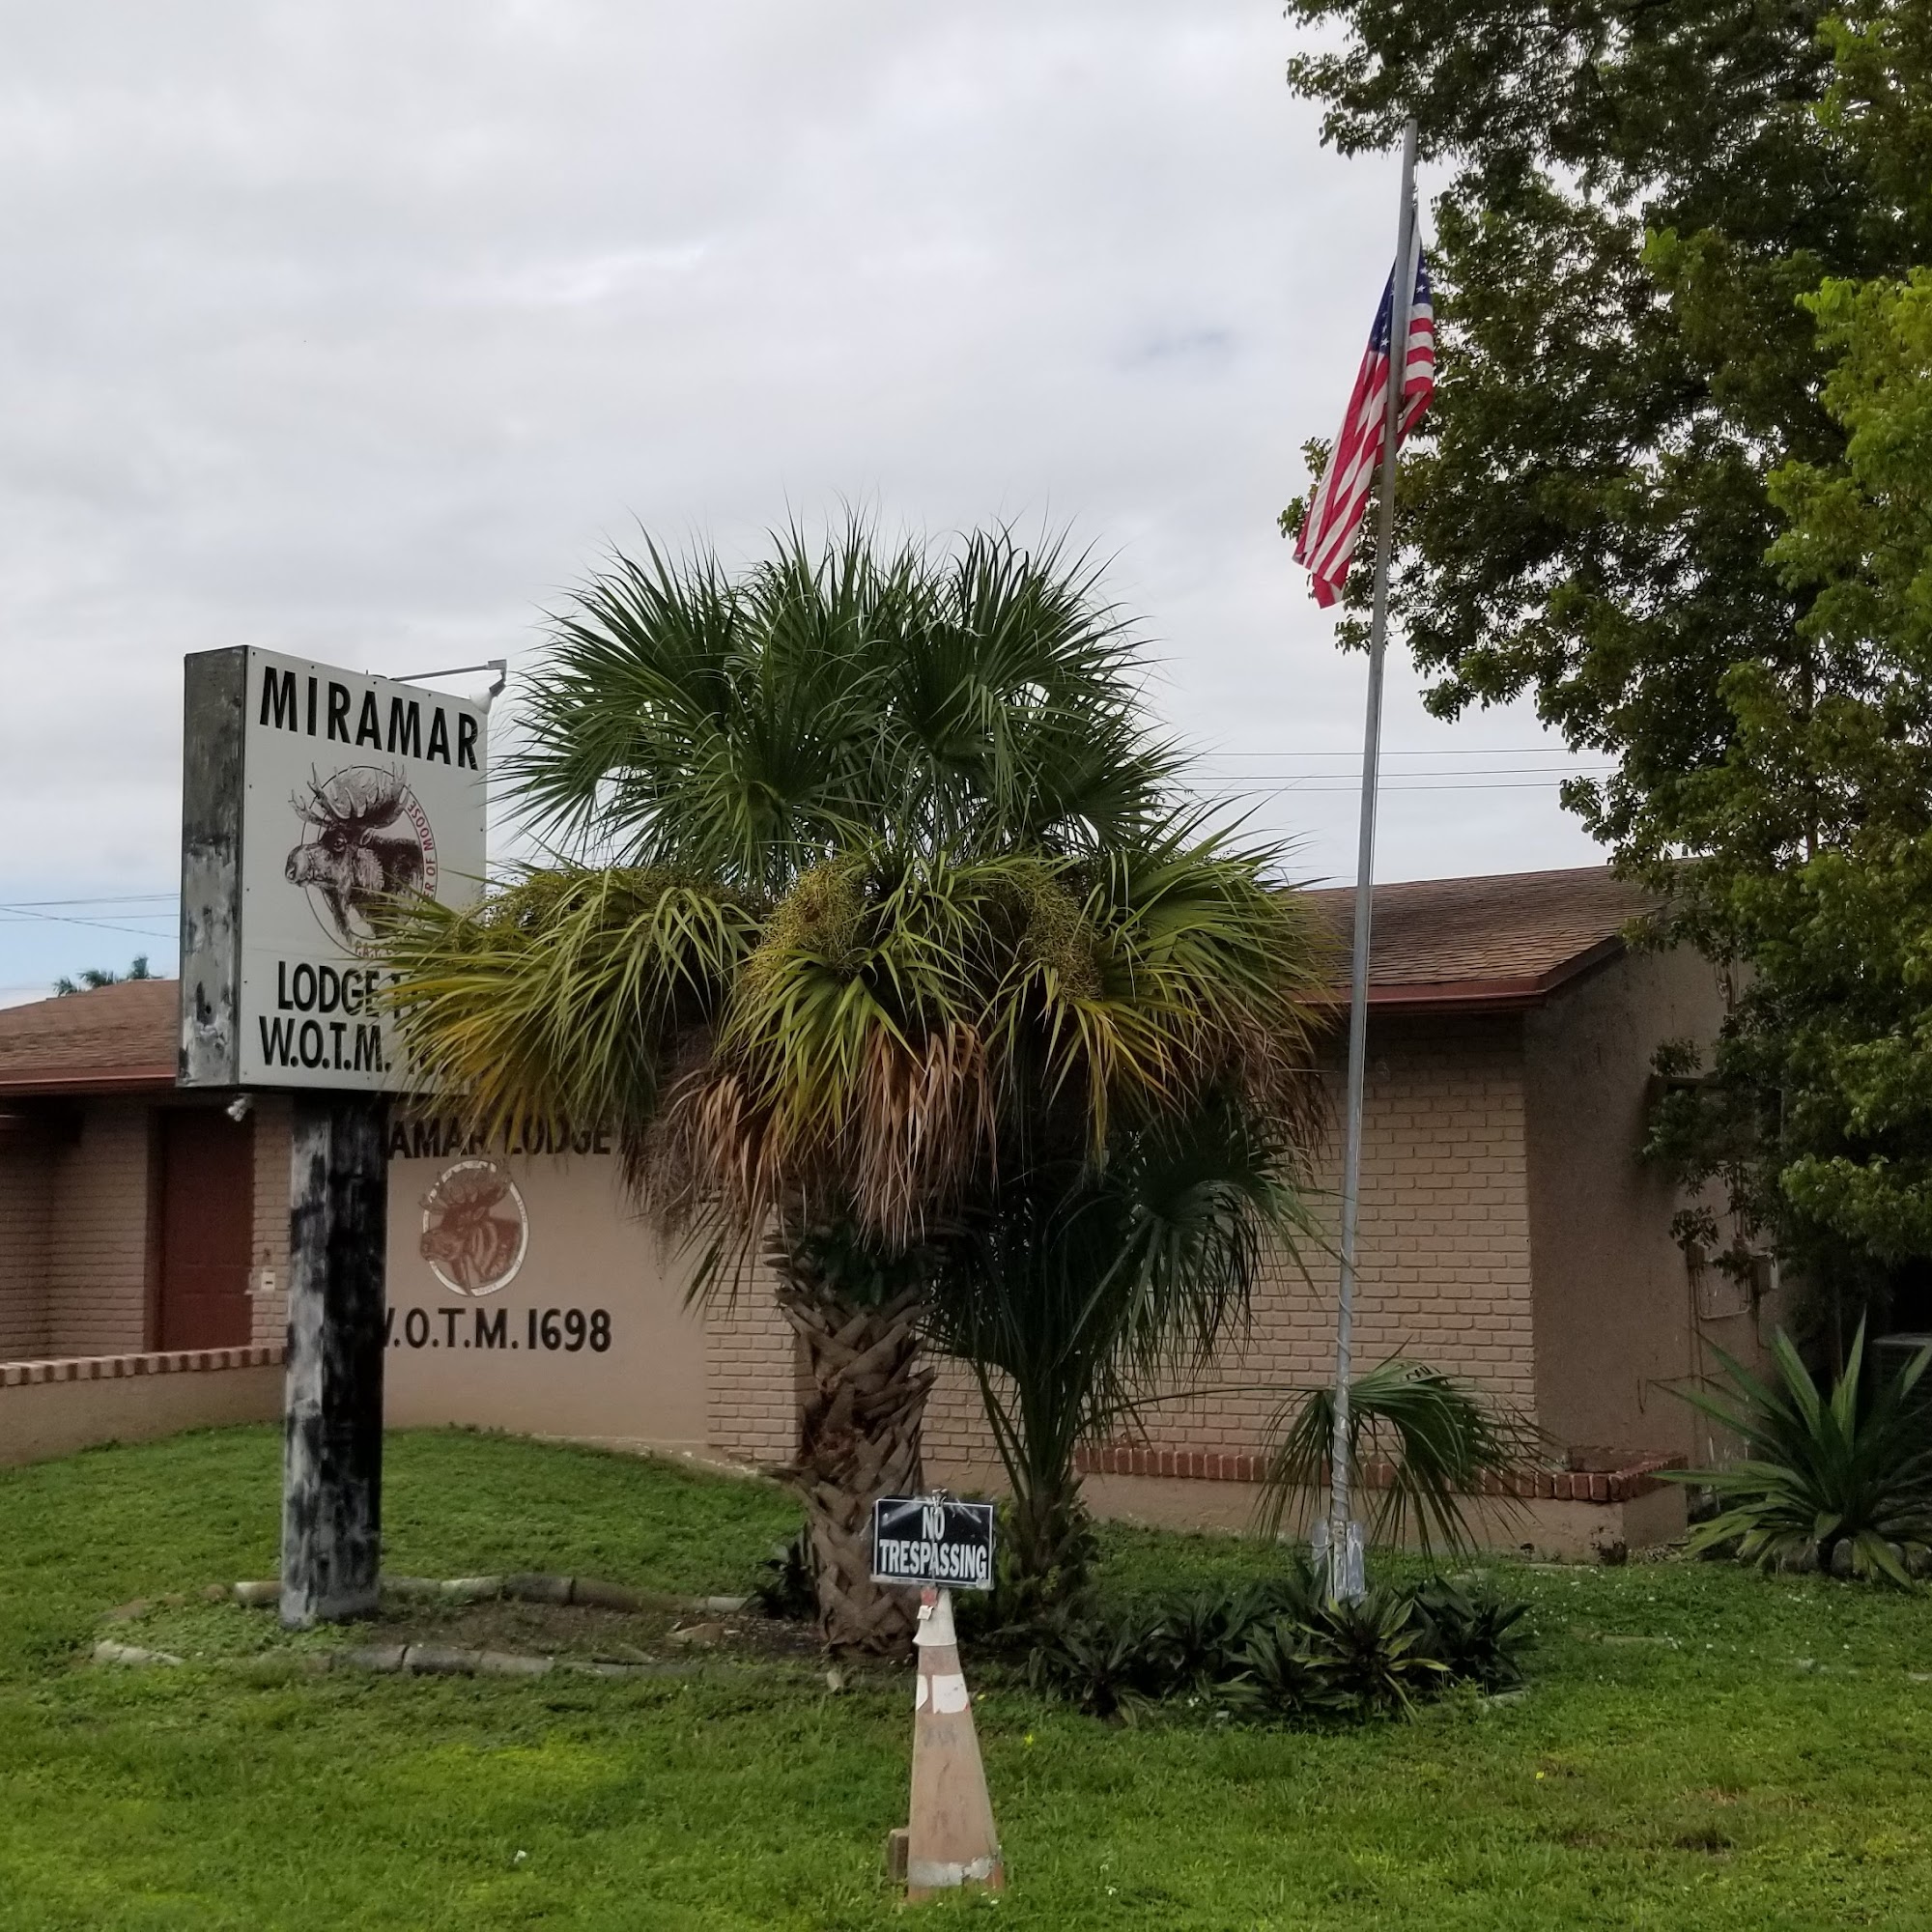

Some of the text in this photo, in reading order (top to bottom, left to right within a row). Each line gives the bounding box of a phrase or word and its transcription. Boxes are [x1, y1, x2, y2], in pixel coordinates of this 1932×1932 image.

[259, 666, 479, 771] MIRAMAR
[407, 800, 435, 852] MOOSE
[277, 960, 381, 1018] LODGE
[258, 1015, 392, 1073] W.O.T.M.
[504, 1116, 611, 1156] LODGE
[527, 1308, 612, 1353] 1698
[922, 1505, 946, 1541] NO
[878, 1539, 987, 1579] TRESPASSING
